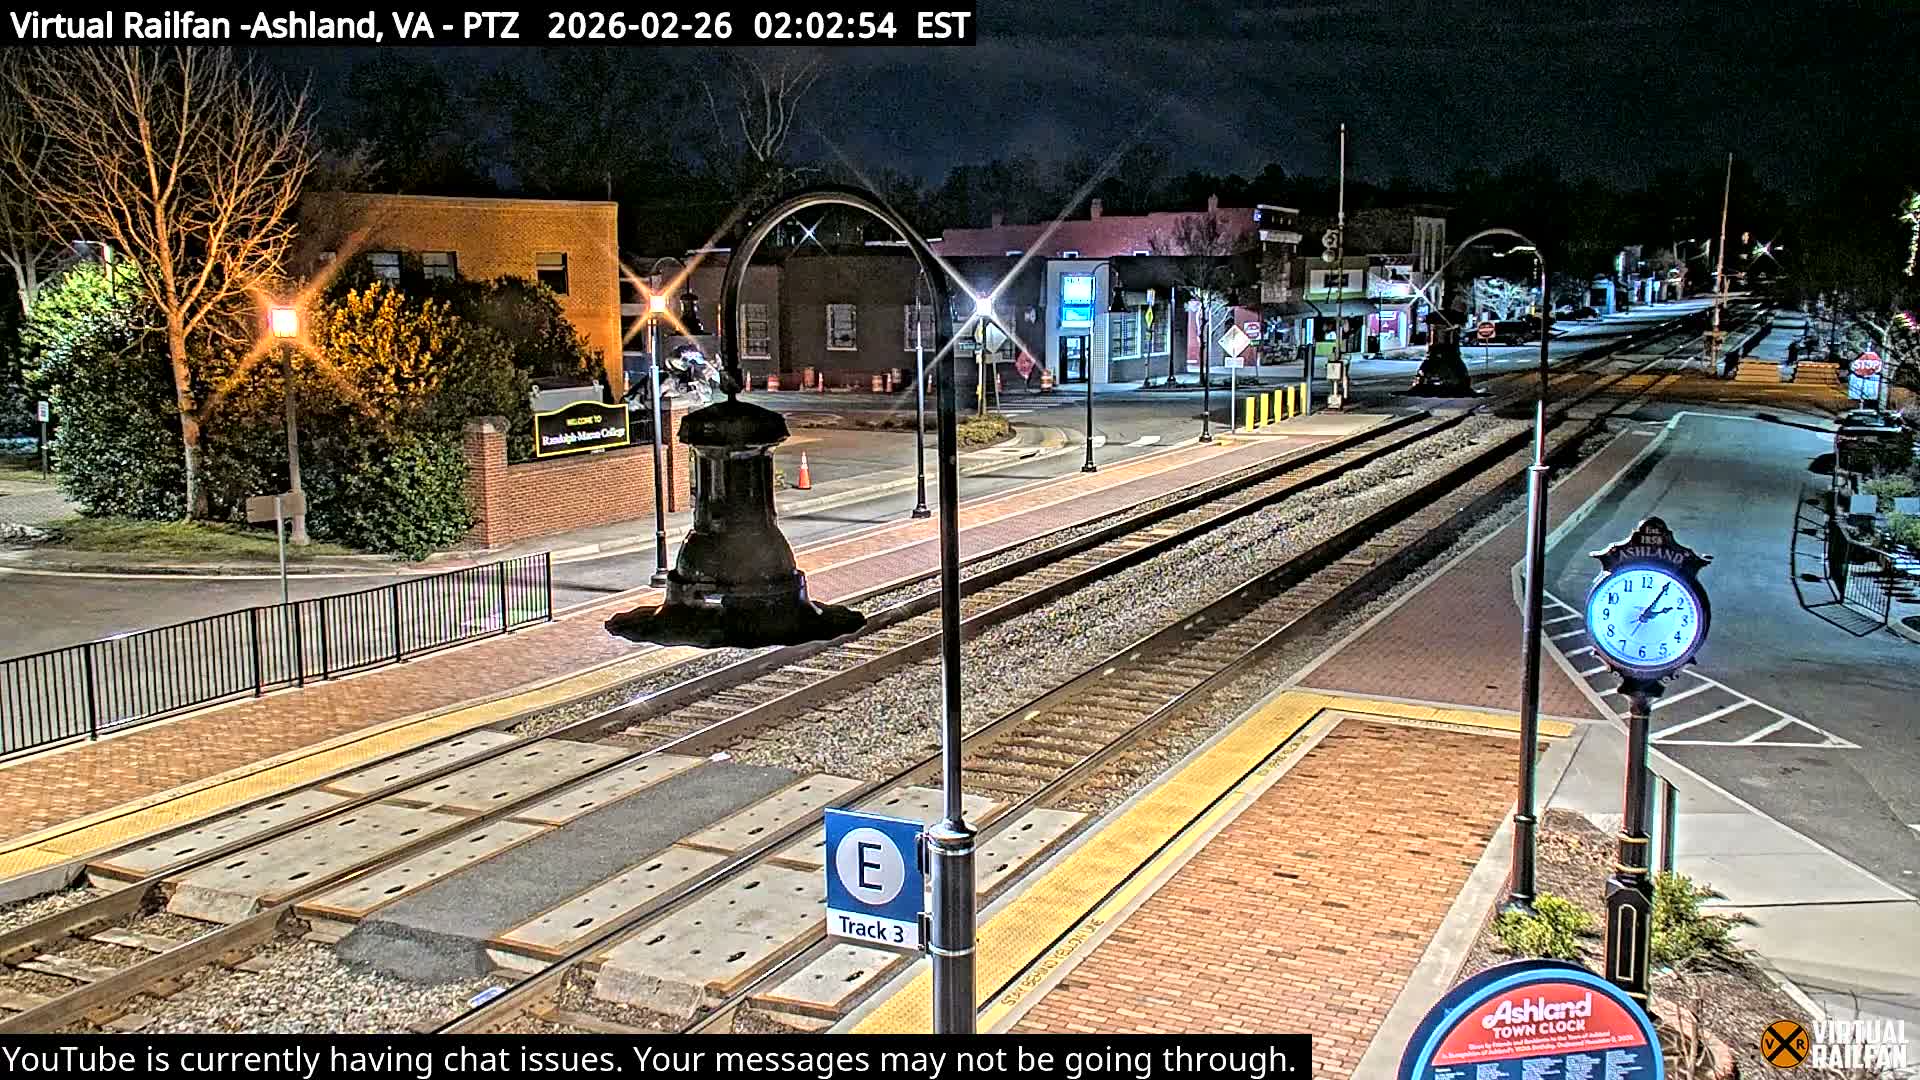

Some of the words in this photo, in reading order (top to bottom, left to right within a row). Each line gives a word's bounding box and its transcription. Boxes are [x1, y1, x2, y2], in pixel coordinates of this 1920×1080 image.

[1851, 359, 1880, 370] STOP
[566, 416, 593, 426] WELCOME
[593, 415, 603, 424] TO
[601, 427, 626, 438] College
[1618, 546, 1685, 565] ASHLAND
[1624, 579, 1632, 592] 11
[1641, 577, 1653, 589] 12
[1608, 592, 1620, 605] 10
[1677, 597, 1685, 610] 2
[1602, 608, 1610, 621] 9
[1681, 615, 1689, 627] 3
[1606, 624, 1616, 638] 8
[1673, 631, 1681, 643] 4
[1618, 639, 1627, 652] 7
[1638, 645, 1647, 658] 6
[1658, 642, 1668, 656] 5
[858, 841, 883, 891] E
[838, 916, 887, 941] Track
[893, 925, 904, 943] 3
[1482, 992, 1592, 1029] Ashland
[1493, 1025, 1536, 1039] TOWN
[1540, 1019, 1586, 1035] CLOCK
